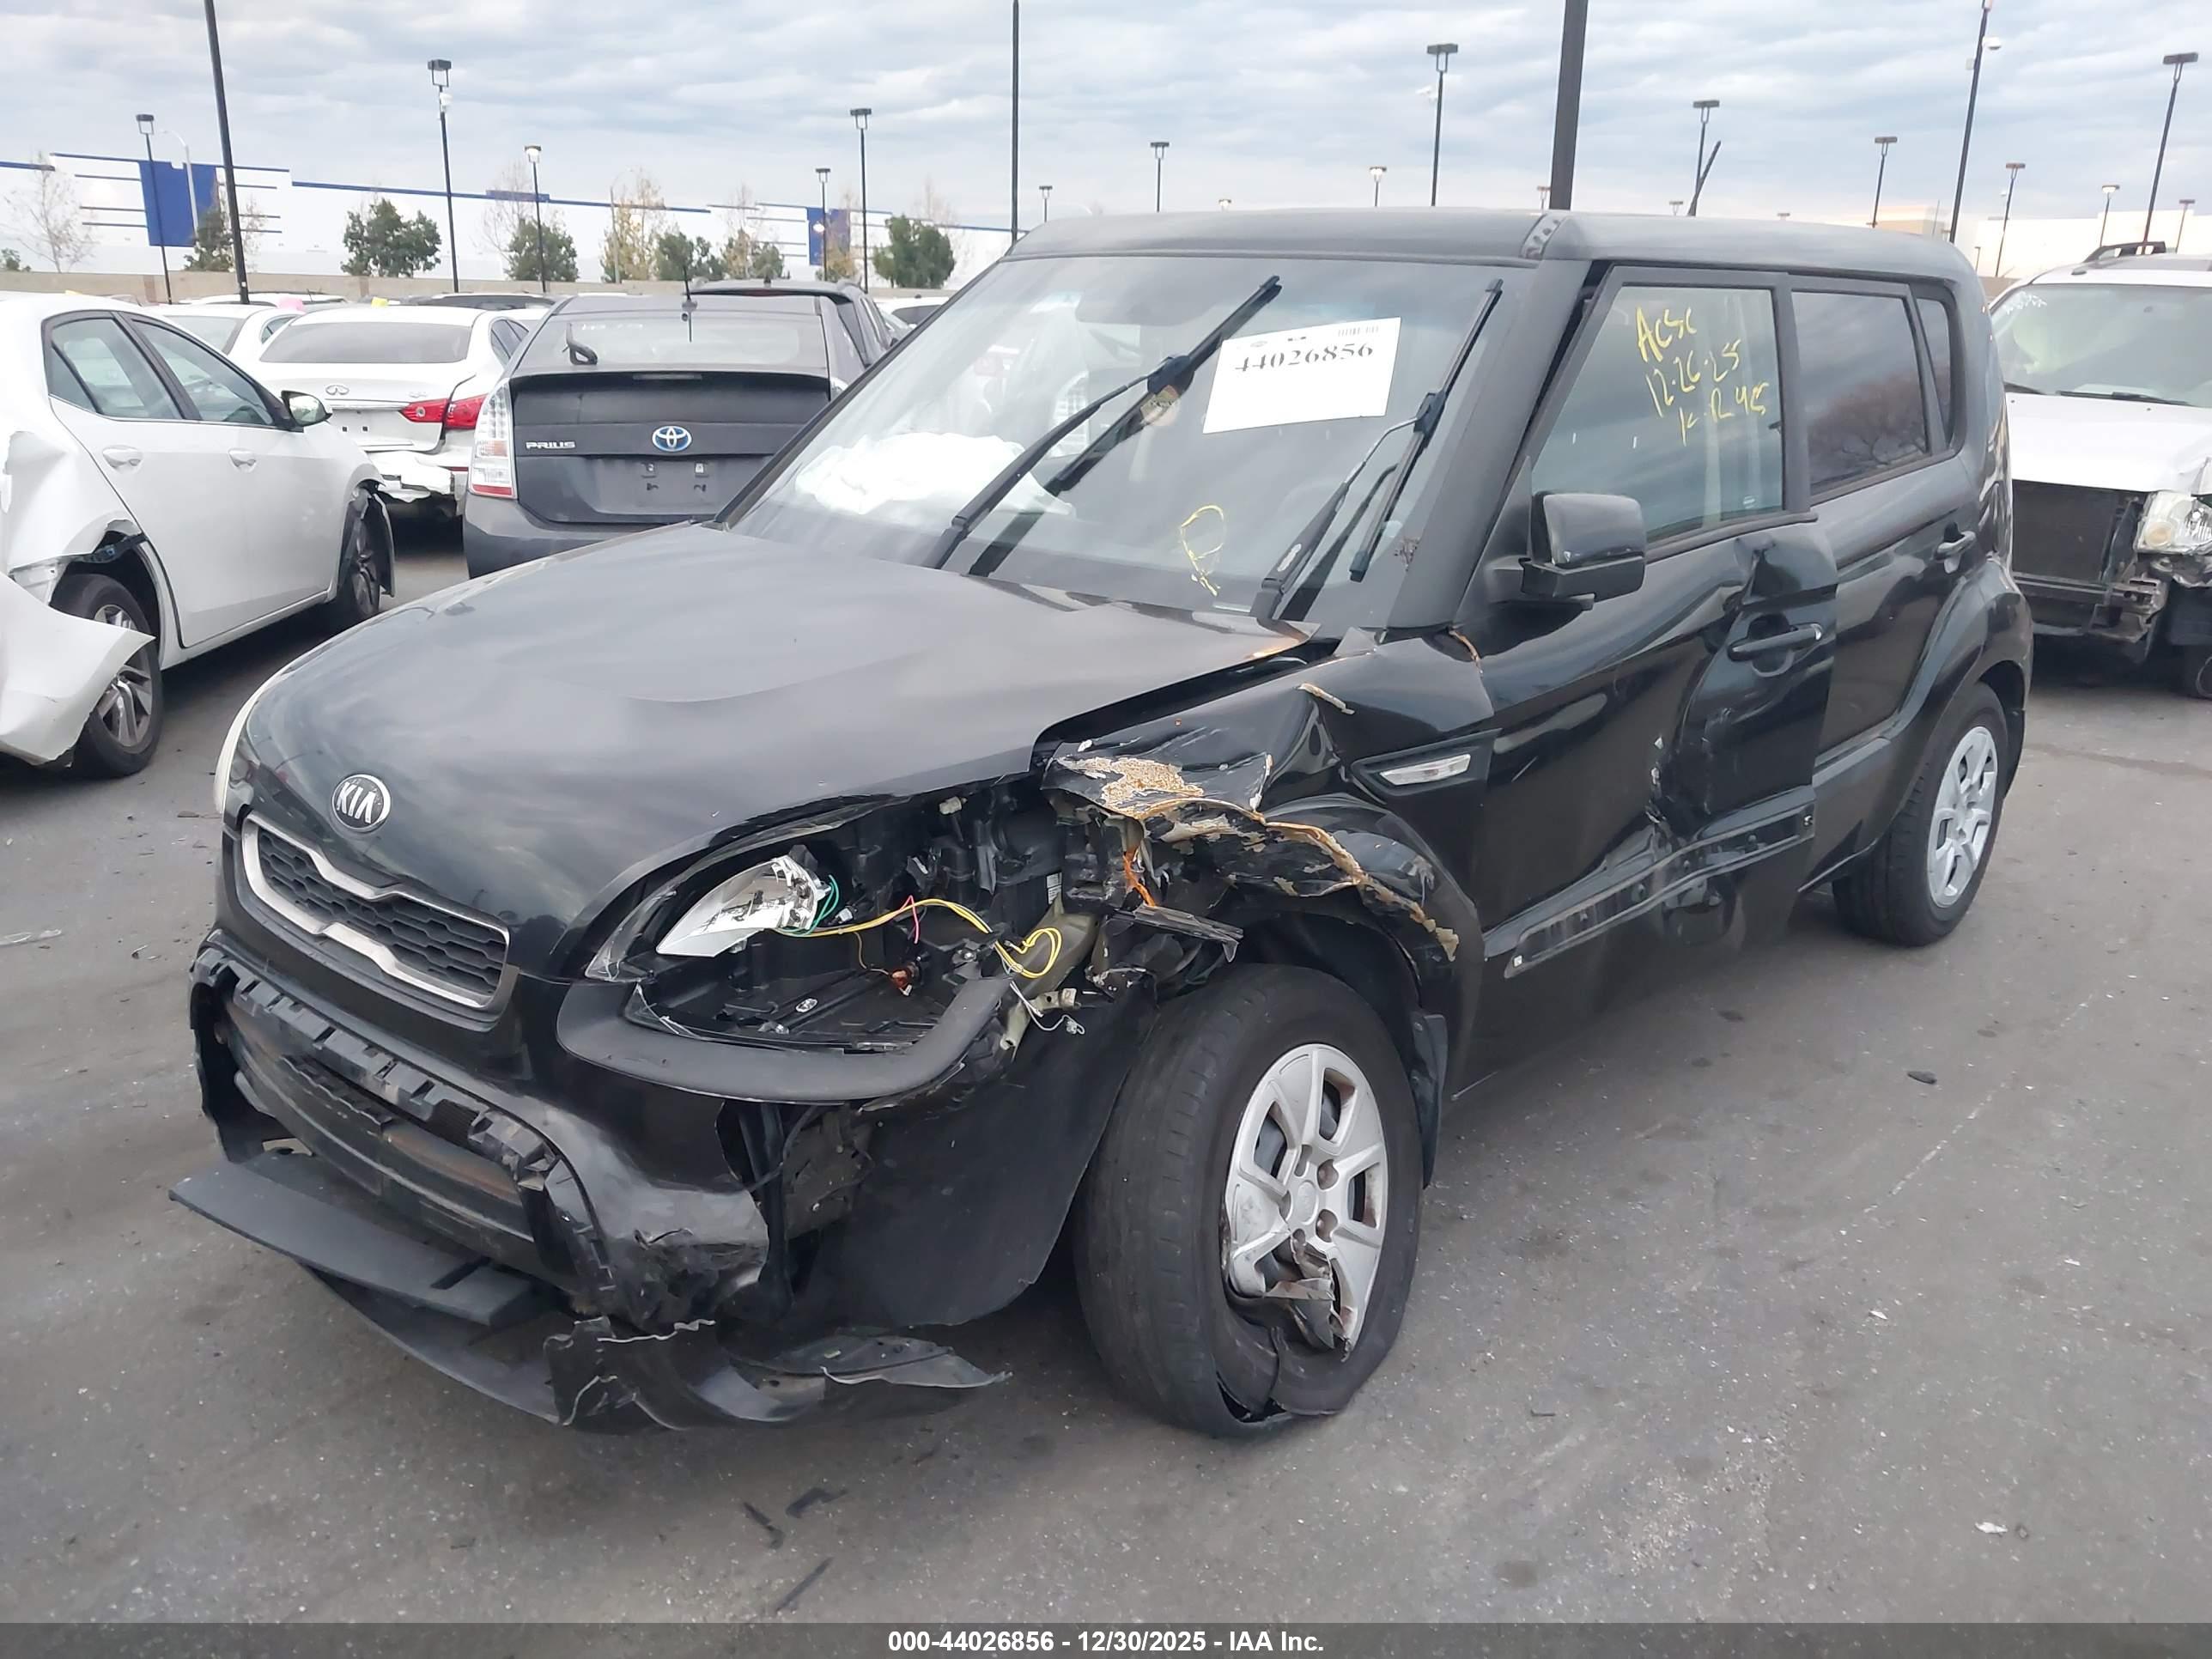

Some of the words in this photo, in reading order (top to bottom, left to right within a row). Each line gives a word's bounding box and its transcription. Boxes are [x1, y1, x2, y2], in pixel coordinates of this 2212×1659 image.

[1235, 342, 1374, 373] 44026856
[525, 441, 576, 450] PRIUS
[336, 781, 377, 824] KIA
